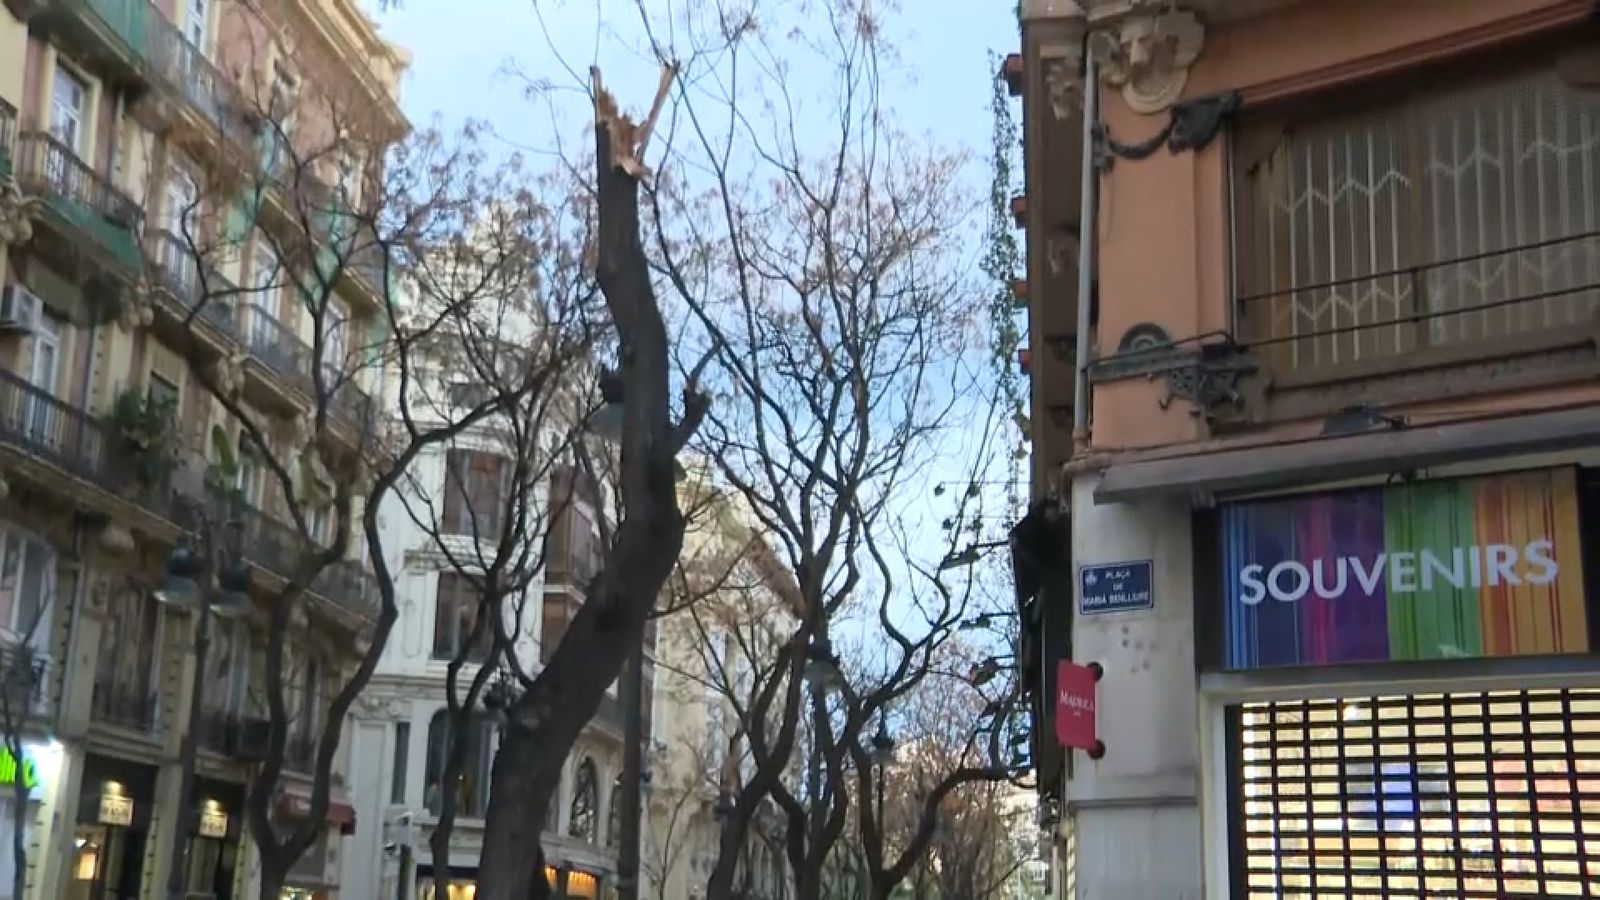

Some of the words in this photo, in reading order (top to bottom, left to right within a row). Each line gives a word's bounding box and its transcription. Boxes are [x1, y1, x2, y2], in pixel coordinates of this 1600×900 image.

[1105, 570, 1130, 580] PLAÇA
[1239, 539, 1560, 606] SOUVENIRS
[1112, 583, 1123, 591] DE
